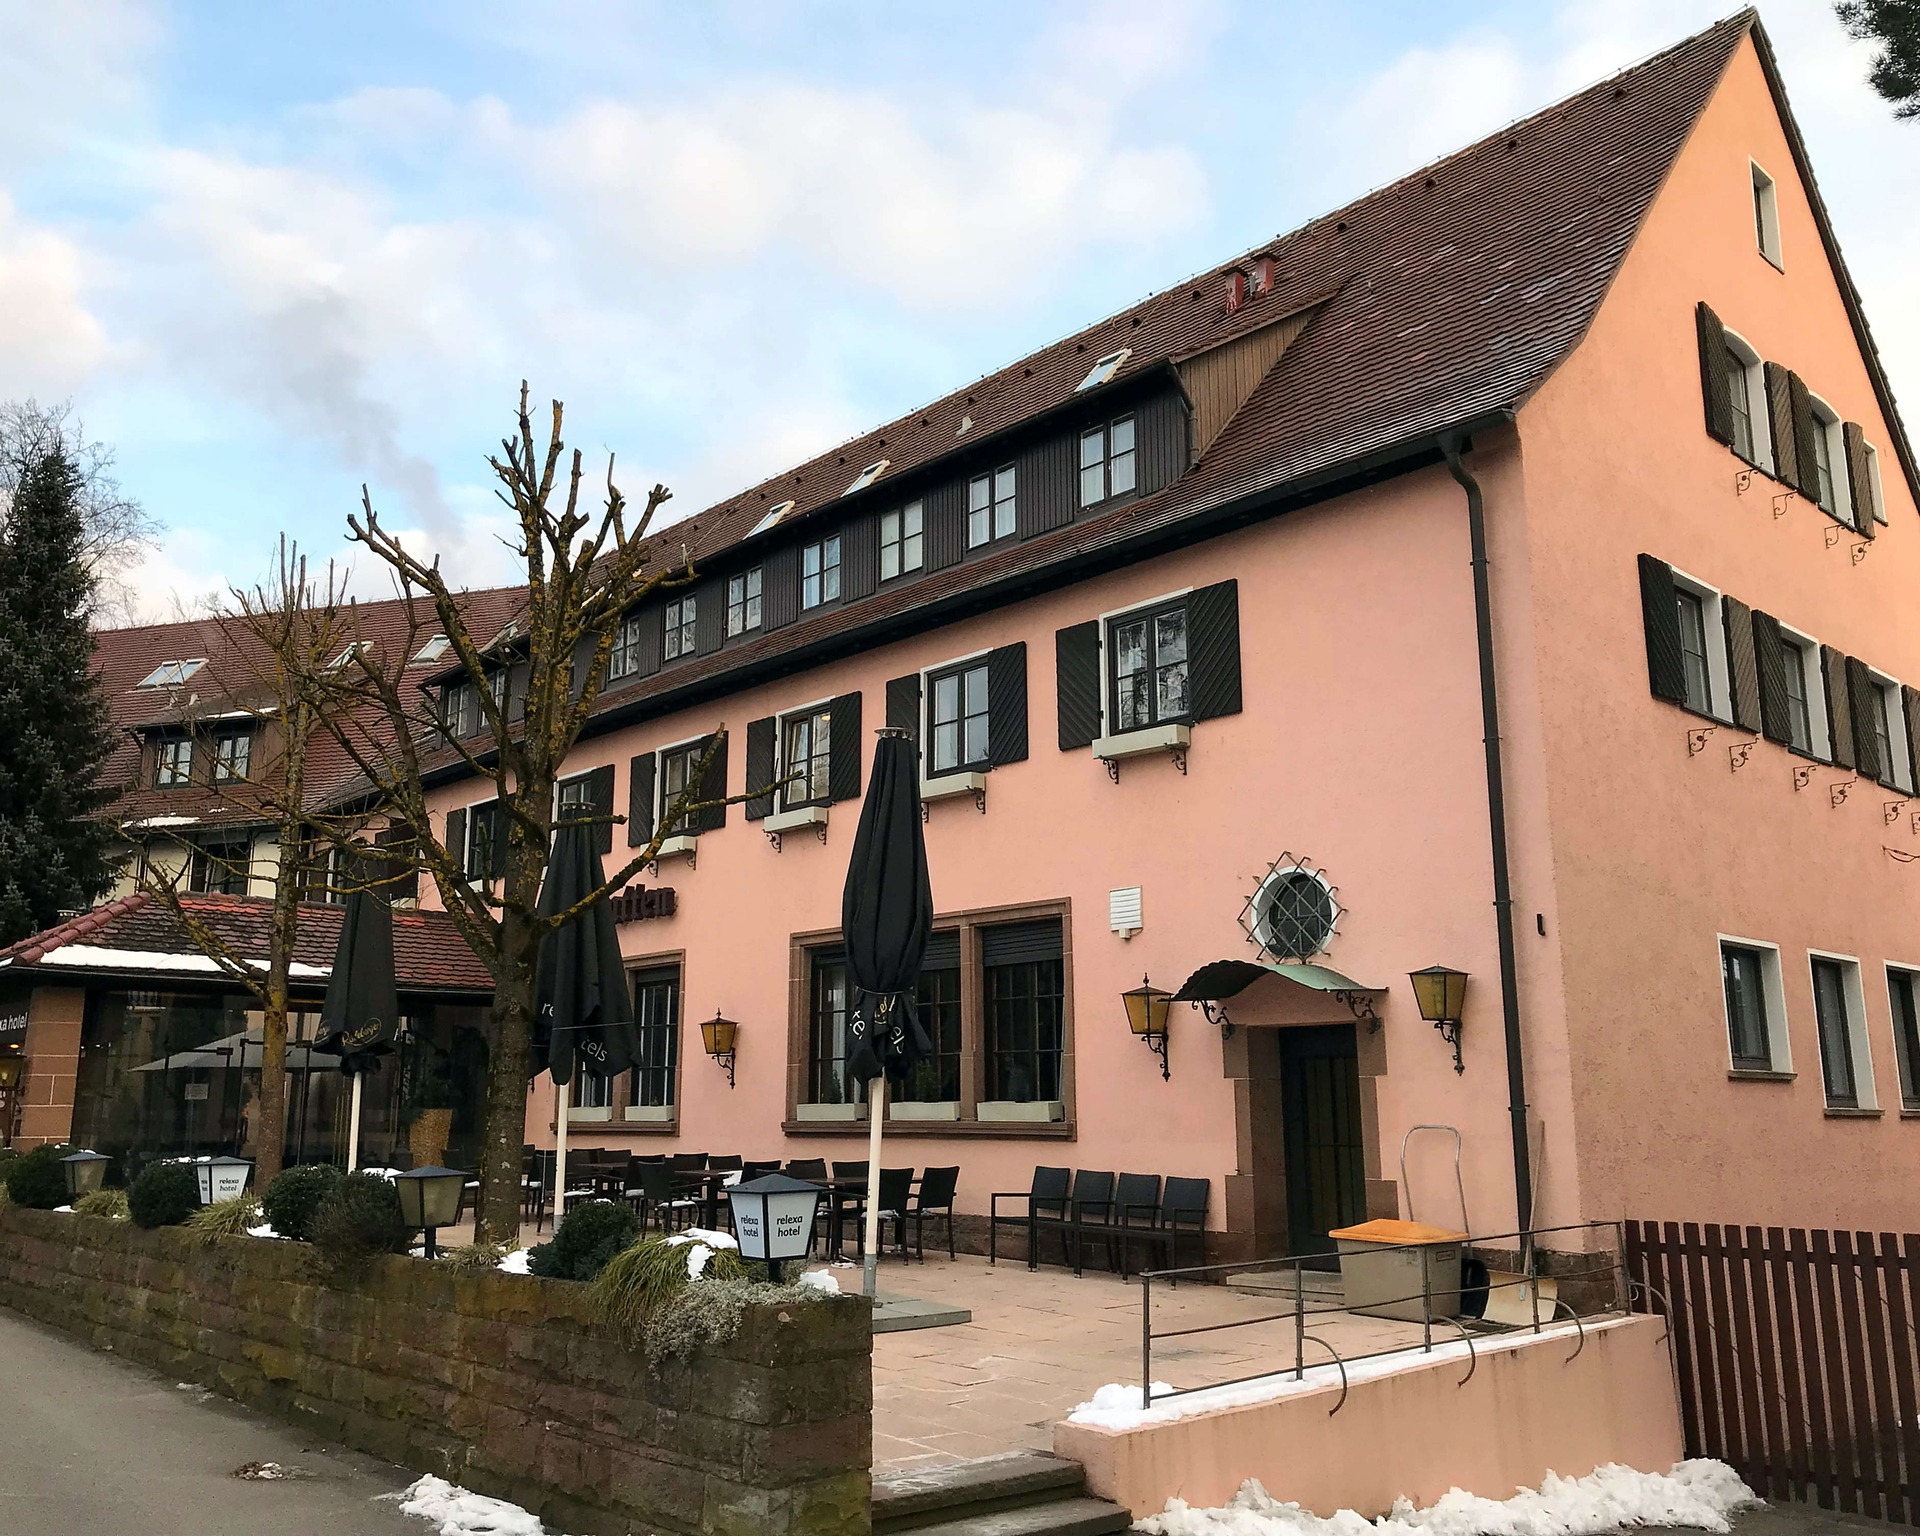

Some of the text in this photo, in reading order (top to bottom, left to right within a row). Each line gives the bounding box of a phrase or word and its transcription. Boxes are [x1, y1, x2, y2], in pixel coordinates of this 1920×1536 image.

[7, 1011, 28, 1031] hotel
[740, 1214, 759, 1226] relexa
[776, 1214, 804, 1226] relexa
[743, 1226, 759, 1238] hotel
[777, 1225, 801, 1238] hotel
